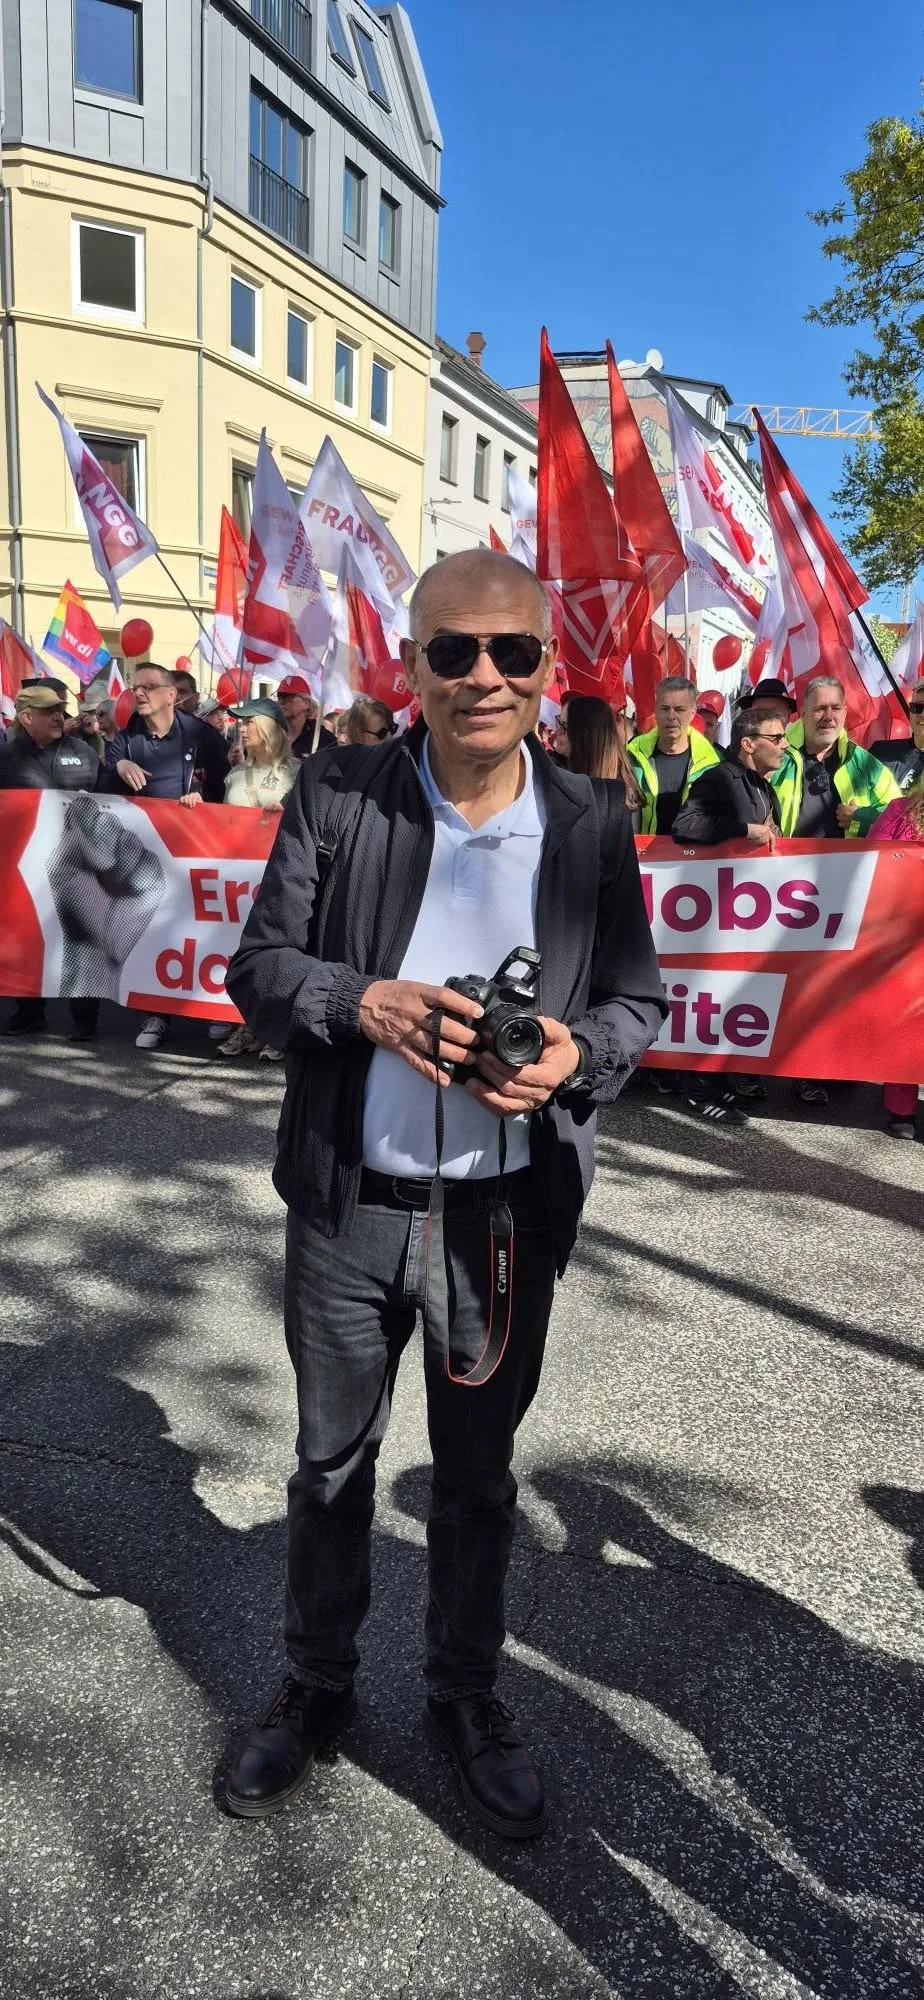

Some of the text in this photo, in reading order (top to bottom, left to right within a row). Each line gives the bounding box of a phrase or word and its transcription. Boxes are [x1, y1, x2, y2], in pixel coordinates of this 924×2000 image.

[88, 482, 139, 547] NGG
[189, 868, 261, 924] Er
[155, 937, 234, 995] da
[660, 983, 771, 1048] ite
[497, 1249, 507, 1294] Canon
